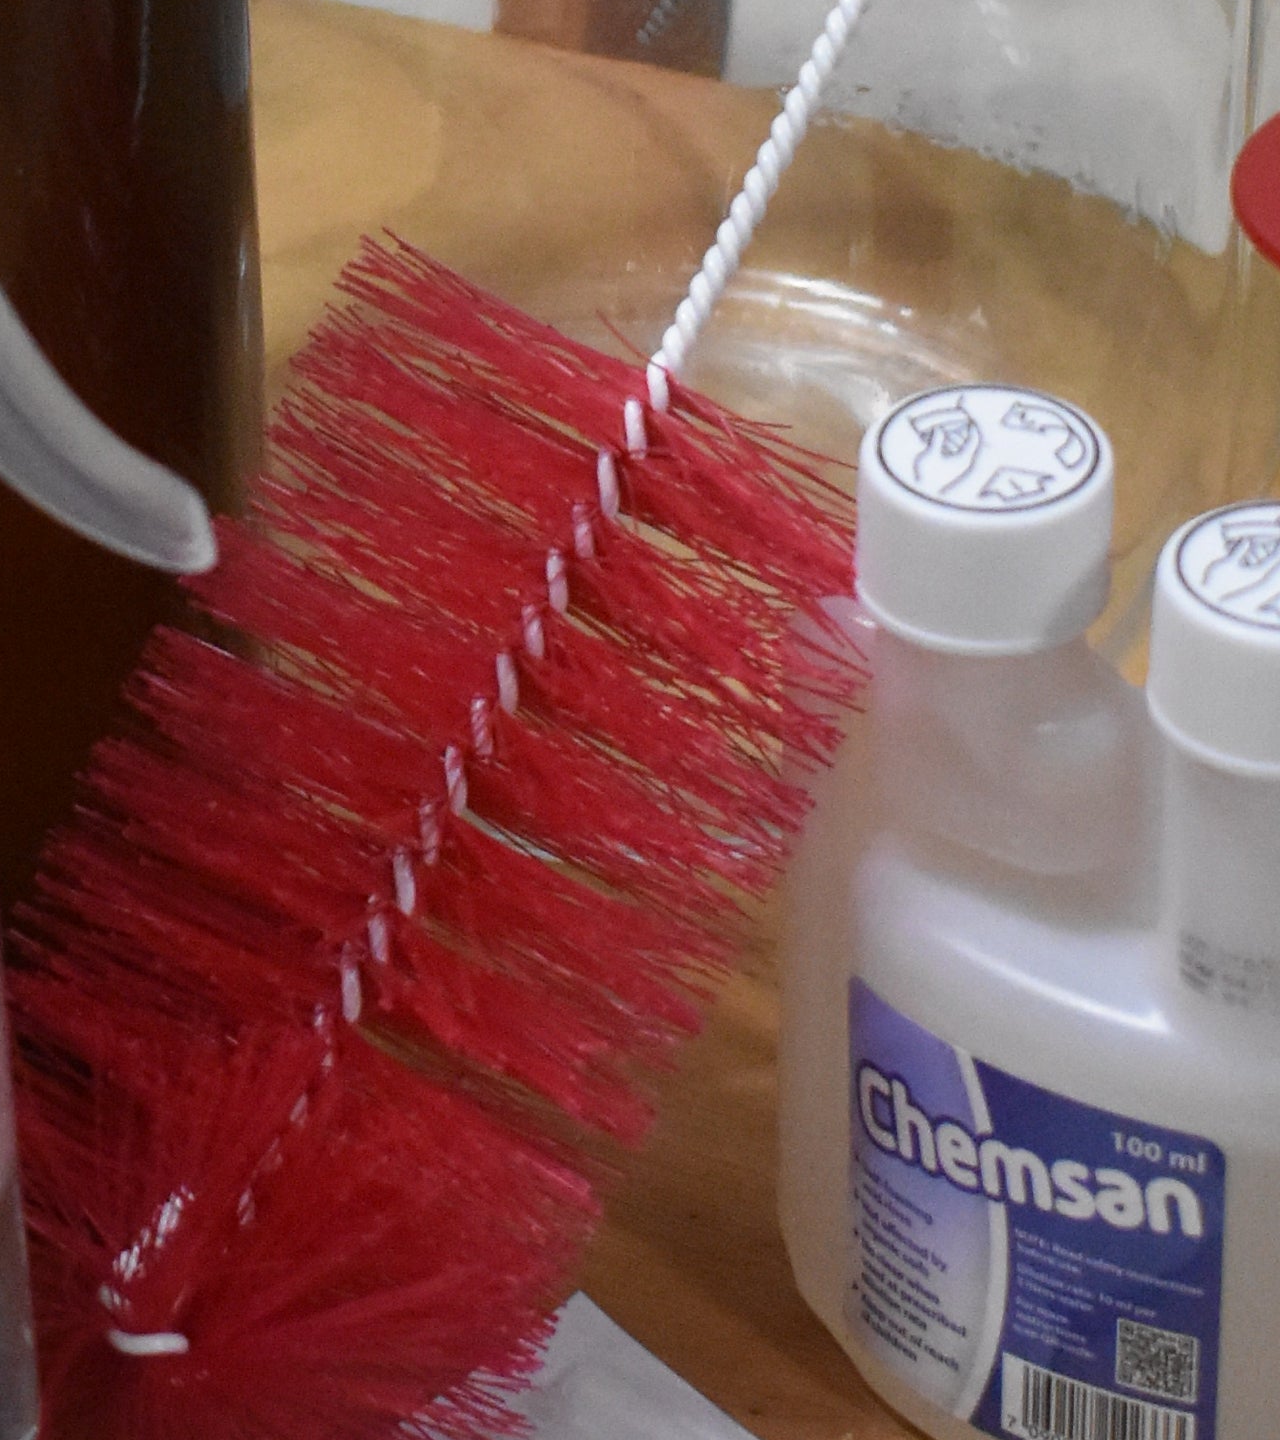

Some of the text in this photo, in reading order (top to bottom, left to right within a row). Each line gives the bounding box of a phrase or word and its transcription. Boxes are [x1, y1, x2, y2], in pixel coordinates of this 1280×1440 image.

[858, 1064, 1205, 1239] Chemsan
[1111, 1131, 1207, 1175] 100 ml
[1006, 1414, 1017, 1428] 7
